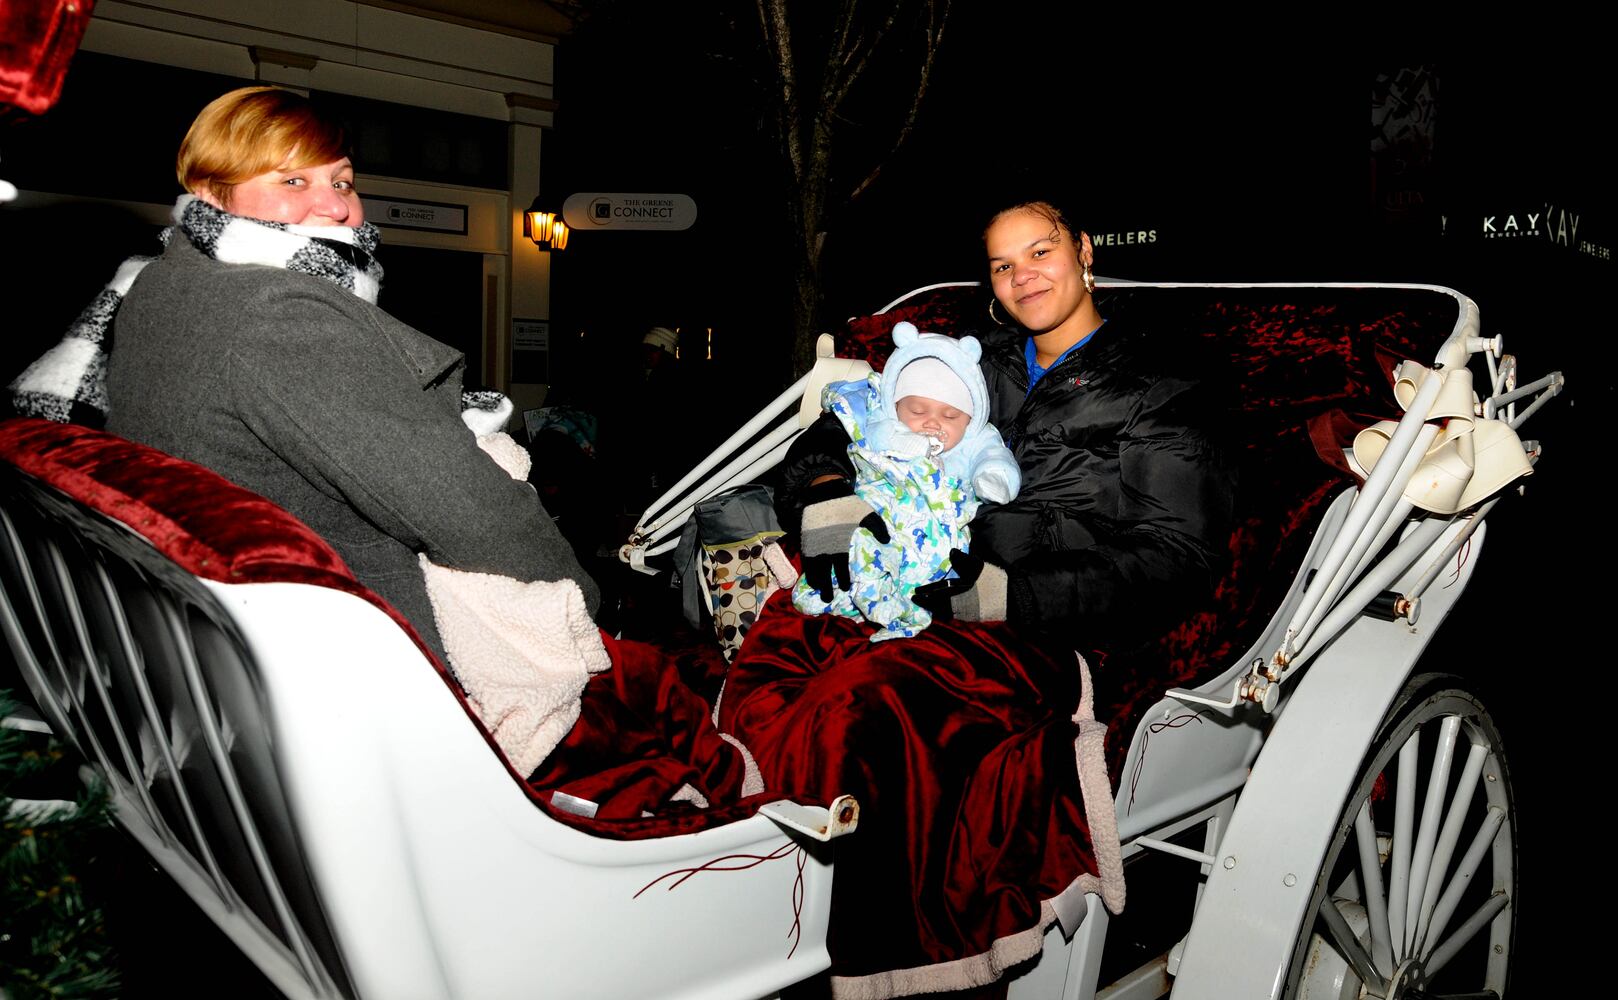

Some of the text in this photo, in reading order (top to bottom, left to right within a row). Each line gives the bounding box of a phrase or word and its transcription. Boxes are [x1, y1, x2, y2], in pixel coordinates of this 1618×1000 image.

[401, 211, 435, 220] CONNECT
[614, 207, 674, 218] CONNECT
[1483, 213, 1540, 232] KAY
[1093, 229, 1157, 247] WELERS
